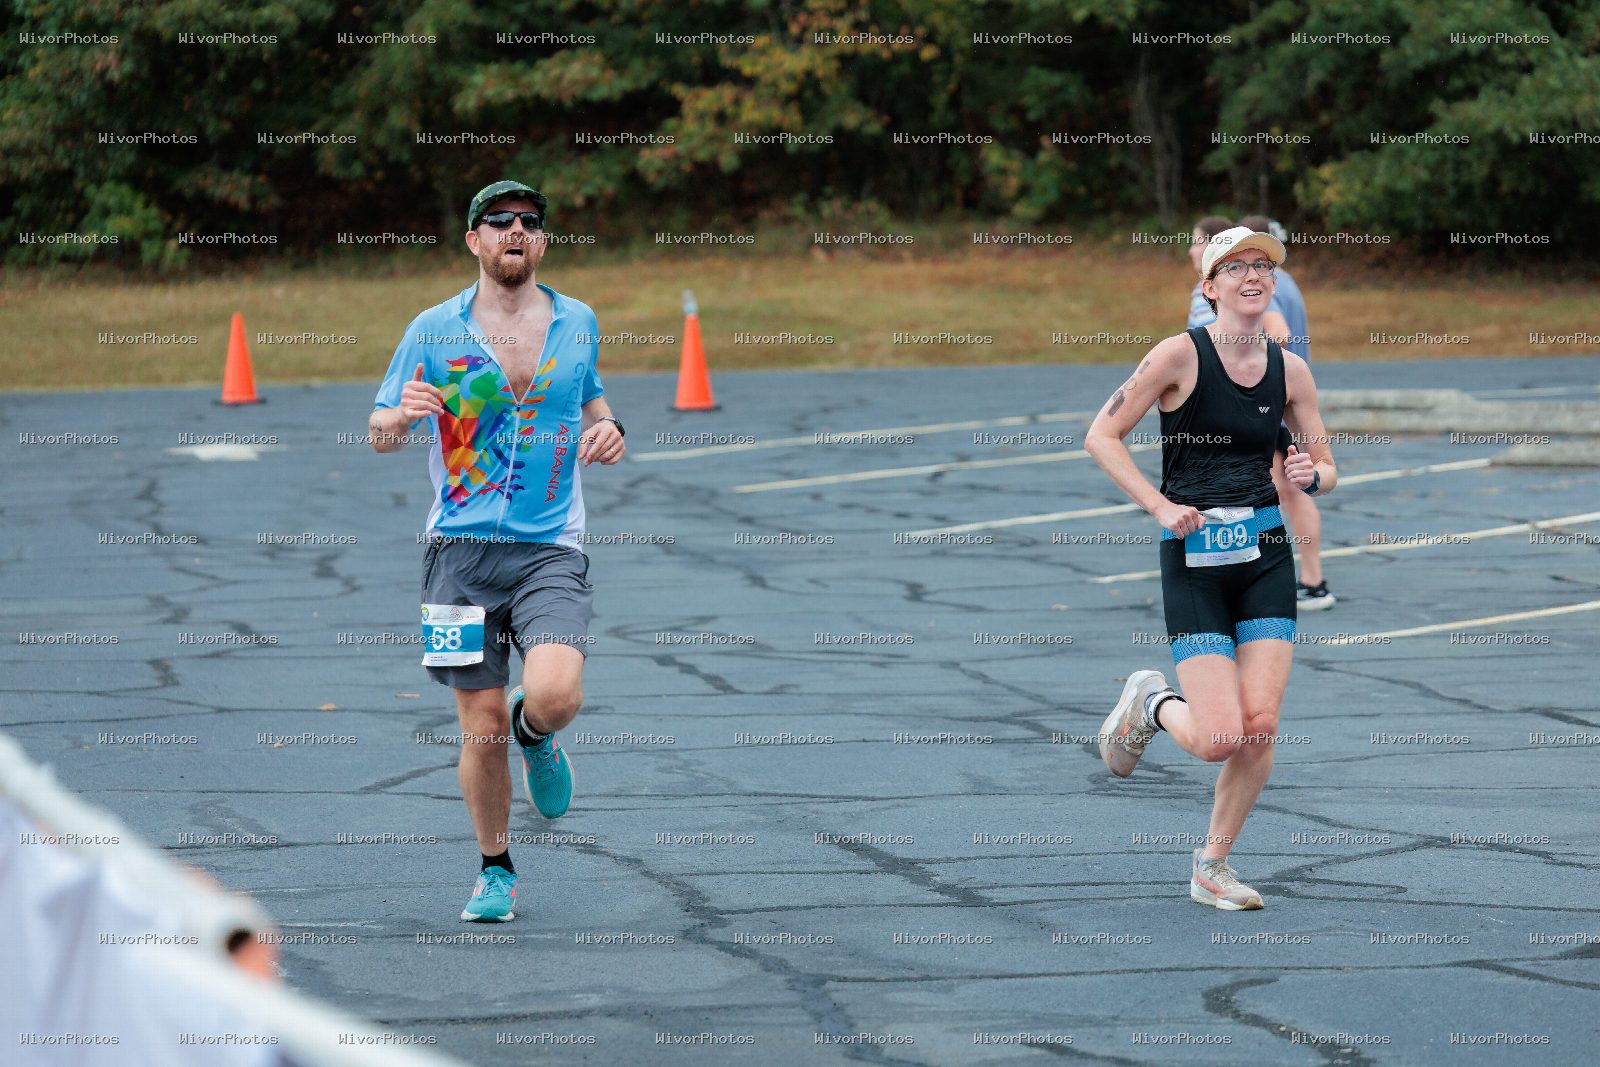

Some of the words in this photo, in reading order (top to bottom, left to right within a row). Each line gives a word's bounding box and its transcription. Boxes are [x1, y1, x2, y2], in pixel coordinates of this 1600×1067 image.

[561, 362, 585, 418] CYCLE
[1200, 523, 1247, 549] 109
[432, 627, 462, 650] 68
